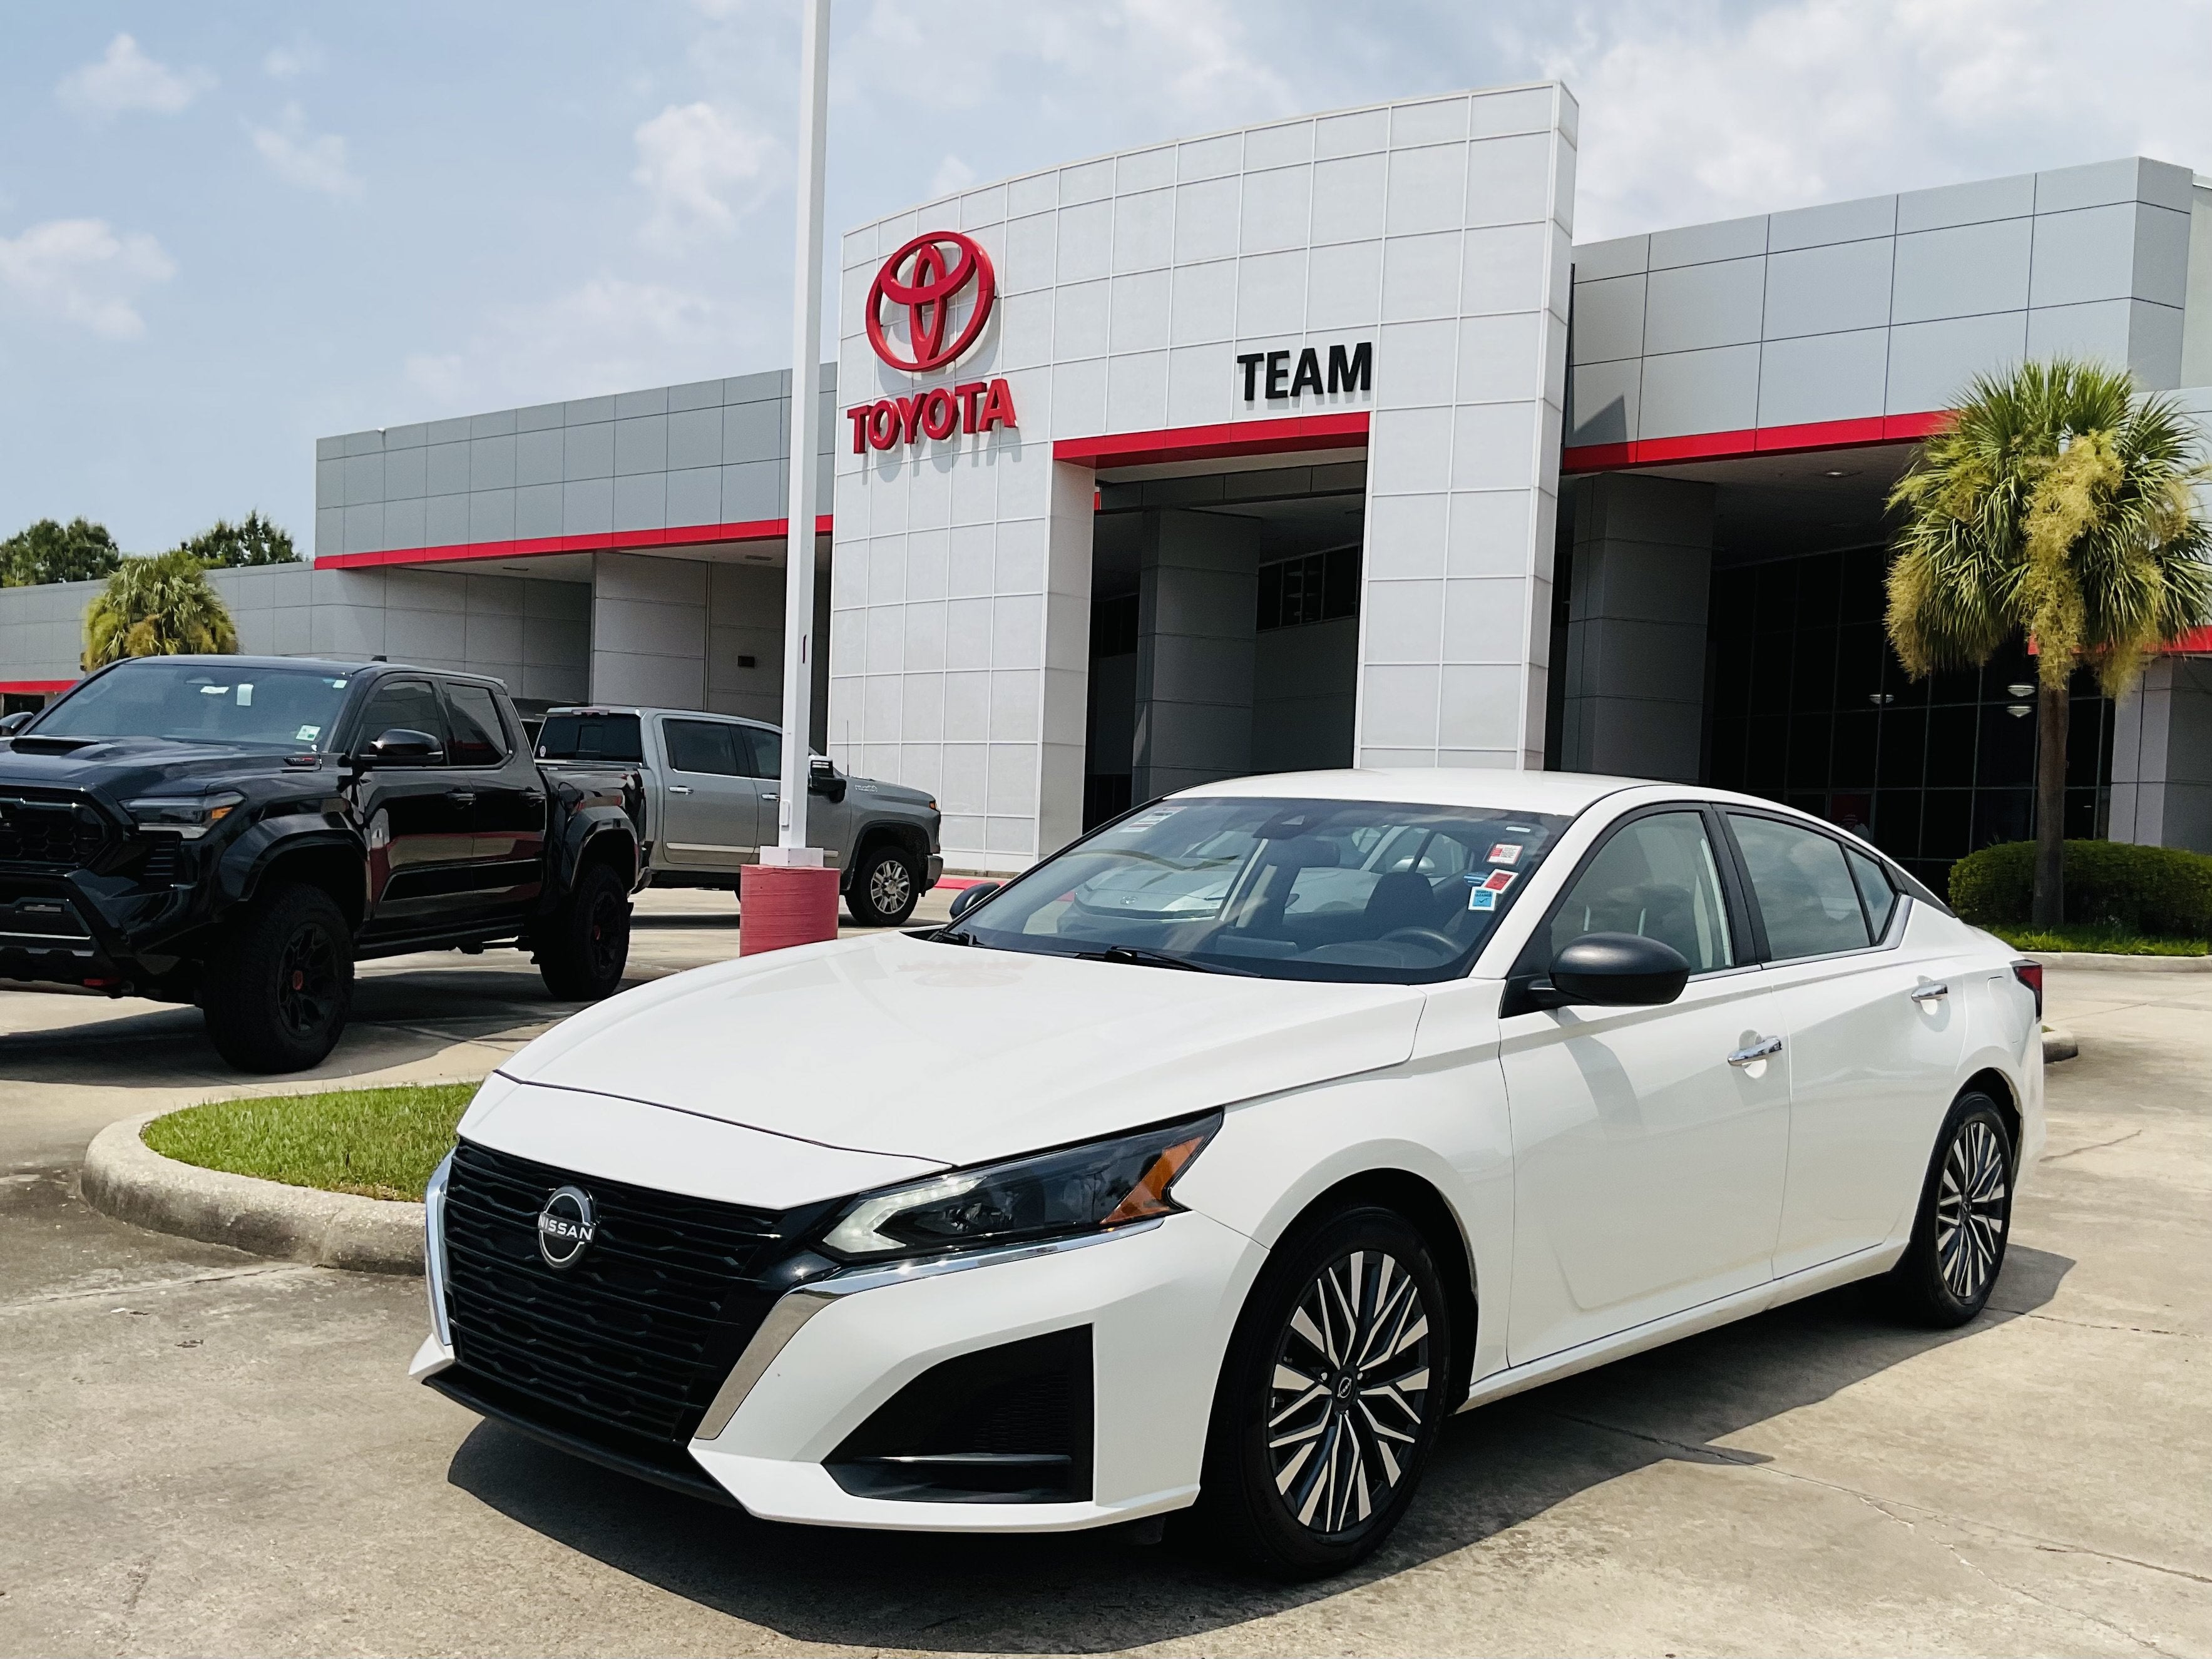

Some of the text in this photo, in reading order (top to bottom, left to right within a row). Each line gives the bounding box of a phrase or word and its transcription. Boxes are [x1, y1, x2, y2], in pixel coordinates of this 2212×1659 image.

[1237, 342, 1371, 401] TEAM
[847, 378, 1018, 454] TOYOTA
[538, 1214, 593, 1240] NISSAN
